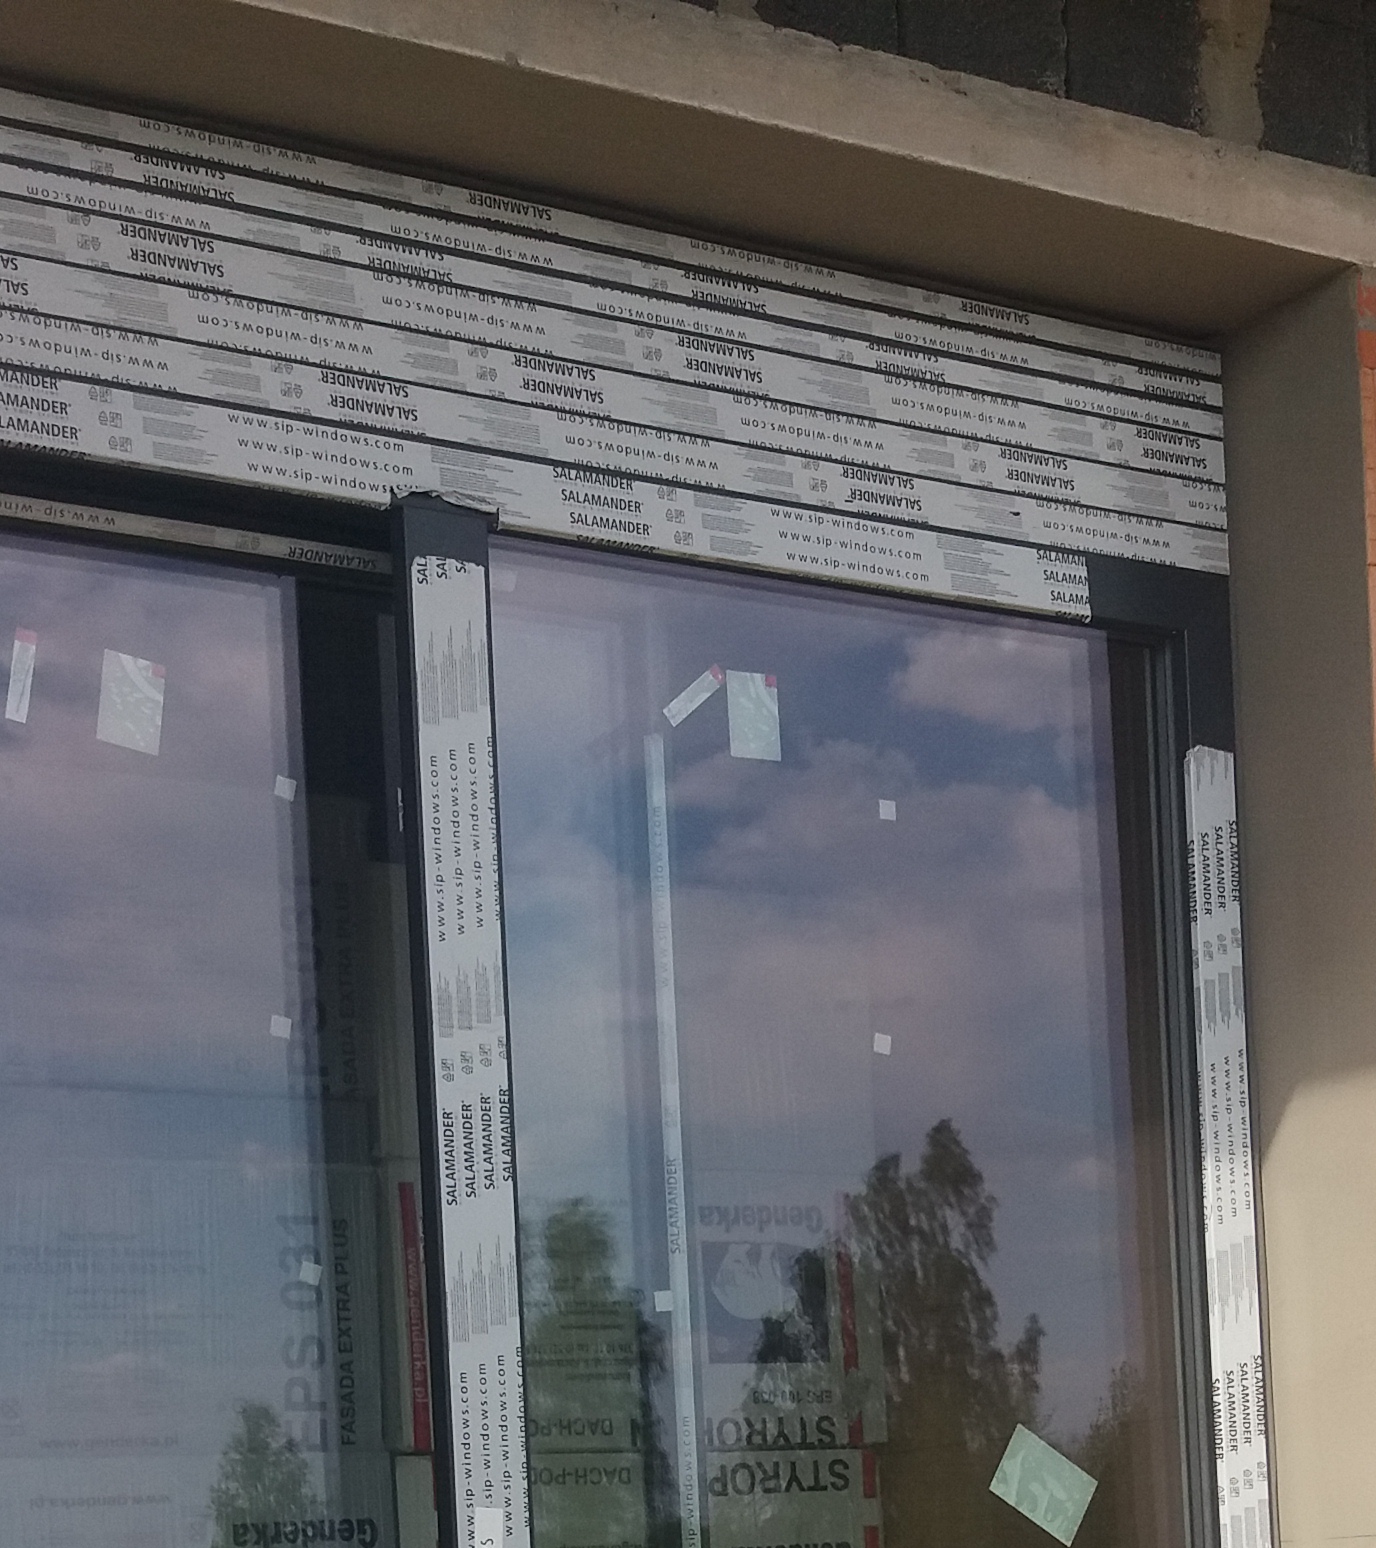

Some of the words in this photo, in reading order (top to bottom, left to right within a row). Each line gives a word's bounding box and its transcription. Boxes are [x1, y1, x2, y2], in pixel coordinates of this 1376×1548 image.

[139, 119, 317, 165] www.sip-windows.com
[26, 185, 211, 231] www.sip-windows.com
[466, 191, 552, 221] SALAMANDER
[119, 222, 215, 254] SALAMANDER
[390, 223, 554, 267] www.sip-windows.com
[129, 246, 224, 278] SALAMANDER
[690, 239, 837, 279] www.sip-windows.com
[381, 296, 546, 336] www.sip-windows.com
[596, 302, 747, 341] www.sip-windows.com
[960, 300, 1030, 325] SALAMANDER
[197, 313, 373, 355] www.sip-windows.com
[675, 335, 755, 362] SALAMANDER
[894, 330, 1029, 366] www.sip-windows.com
[318, 369, 409, 398] SALAMANDER
[511, 353, 596, 381] SALAMANDER
[683, 357, 763, 383] SALAMANDER
[328, 393, 418, 422] SALAMANDER
[519, 377, 604, 405] SALAMANDER
[228, 412, 404, 453] www.sip-windows.com
[891, 396, 1027, 431] www.sip-windows.com
[1065, 397, 1190, 429] www.sip-windows.com
[565, 434, 719, 470] www.sip-windows.com
[741, 417, 884, 450] www.sip-windows.com
[1134, 426, 1201, 450] SALAMANDER
[238, 436, 413, 476] www.sip-windows.com
[998, 447, 1068, 471] SALAMANDER
[1141, 447, 1207, 470] SALAMANDER
[552, 466, 635, 492] SALAMANDER
[840, 466, 915, 490] SALAMANDER
[1005, 468, 1075, 491] SALAMANDER
[561, 488, 644, 514] SALAMANDER
[847, 488, 922, 511] SALAMANDER
[569, 511, 652, 537] SALAMANDER
[770, 507, 915, 540] www.sip-windows.com
[1043, 520, 1170, 549] www.sip-windows.com
[285, 544, 378, 571] SALAMANDER
[778, 528, 922, 561] www.sip-windows.com
[786, 551, 930, 583] www.sip-windows.com
[429, 754, 446, 942] www.sip-windows.com
[448, 748, 465, 935] www.sip-windows.com
[467, 741, 484, 928] www.sip-windows.com
[1201, 832, 1213, 917] SALAMANDER
[1214, 825, 1227, 911] SALAMANDER
[1228, 820, 1240, 903] SALAMANDER
[480, 1092, 496, 1190] SALAMANDER
[498, 1084, 514, 1182] SALAMANDER
[1210, 1063, 1224, 1225] www.sip-windows.com
[1224, 1055, 1238, 1217] www.sip-windows.com
[1237, 1048, 1251, 1211] www.sip-windows.com
[442, 1107, 458, 1206] SALAMANDER
[461, 1100, 477, 1199] SALAMANDER
[667, 1157, 682, 1255] SALAMANDER
[698, 1205, 824, 1233] Genderka
[331, 1218, 349, 1275] PLUS
[335, 1282, 353, 1354] EXTRA
[339, 1360, 356, 1446] FASADA
[1226, 1370, 1239, 1454] SALAMANDER
[1239, 1362, 1252, 1446] SALAMANDER
[1253, 1354, 1266, 1437] SALAMANDER
[496, 1354, 513, 1537] www.sip-windows.com
[707, 1459, 850, 1498] STYROP
